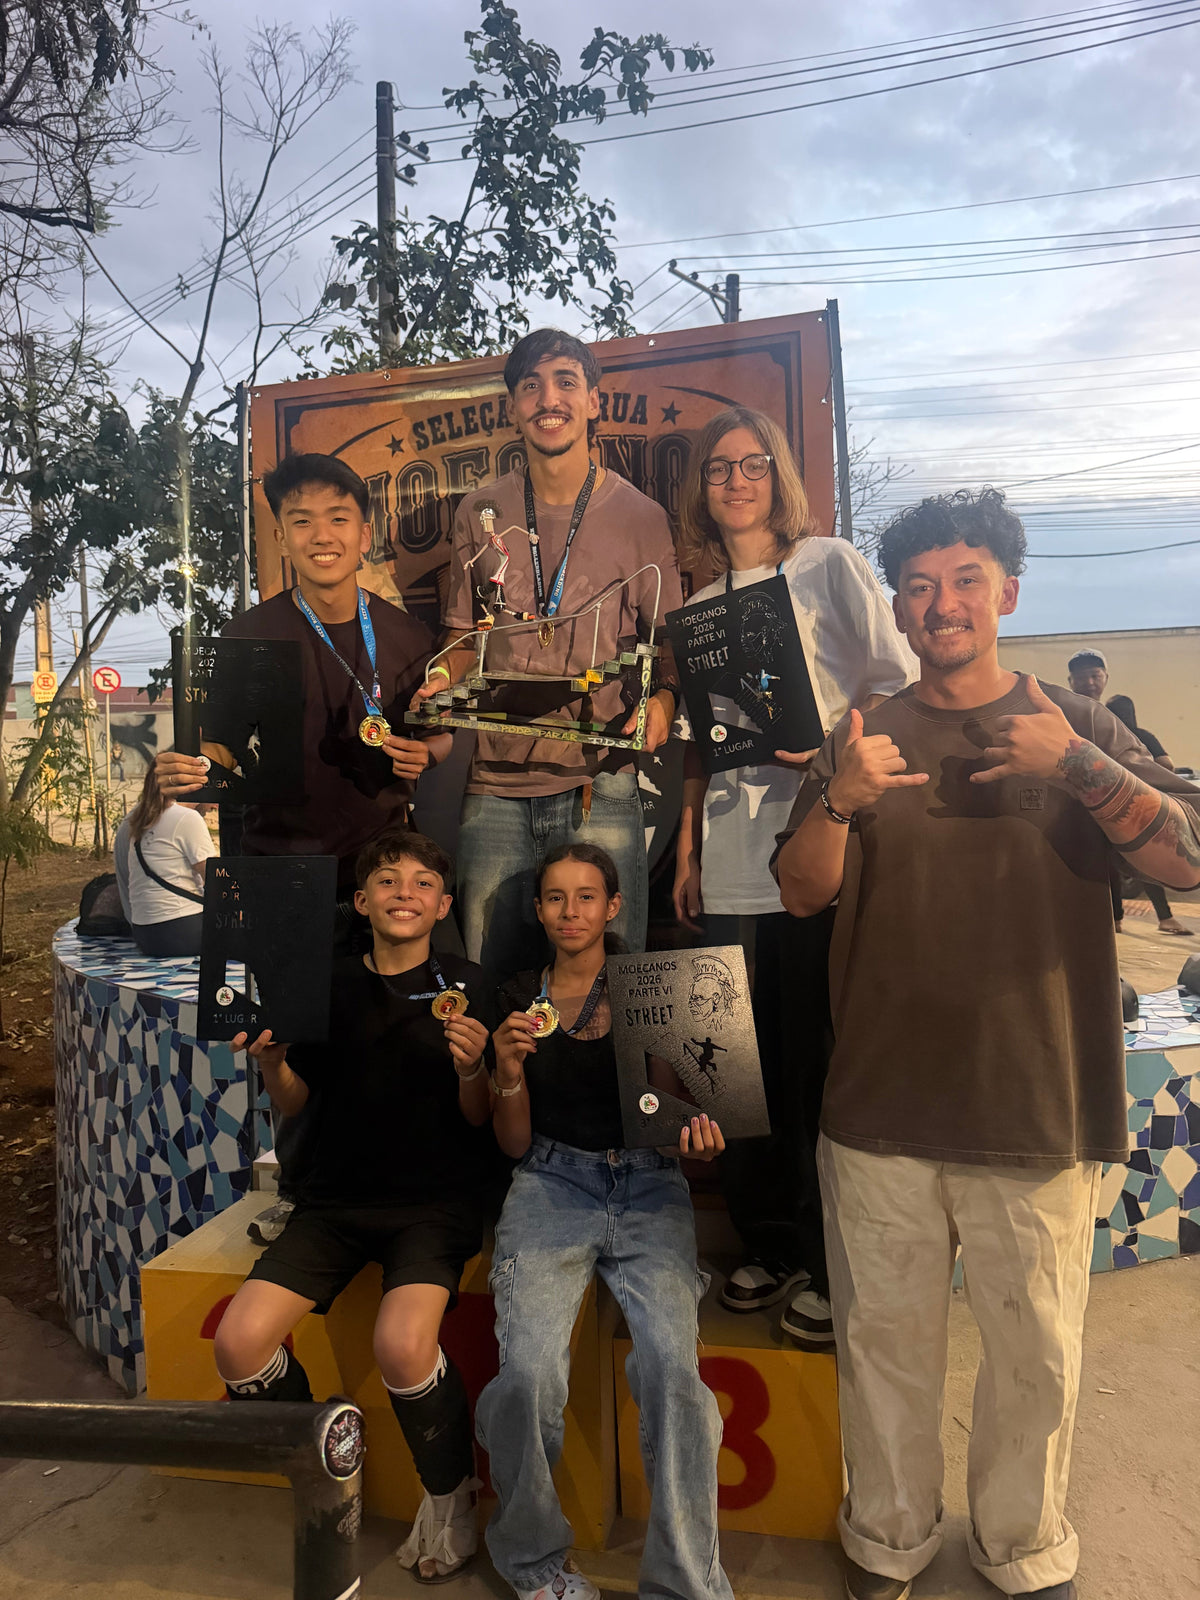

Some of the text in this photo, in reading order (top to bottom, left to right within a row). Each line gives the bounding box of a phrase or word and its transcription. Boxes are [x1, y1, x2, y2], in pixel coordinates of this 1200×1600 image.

[412, 395, 519, 451] SELEÇÃ
[693, 621, 715, 635] 2026
[687, 629, 726, 649] PARTE VI
[198, 659, 215, 667] 202
[687, 646, 729, 674] STREET
[723, 739, 755, 754] LUGAR
[618, 961, 677, 974] MOECANOS
[637, 975, 661, 985] 2026
[627, 986, 673, 998] PARTE VI
[225, 1013, 257, 1024] LUGR
[625, 1004, 673, 1026] STREET
